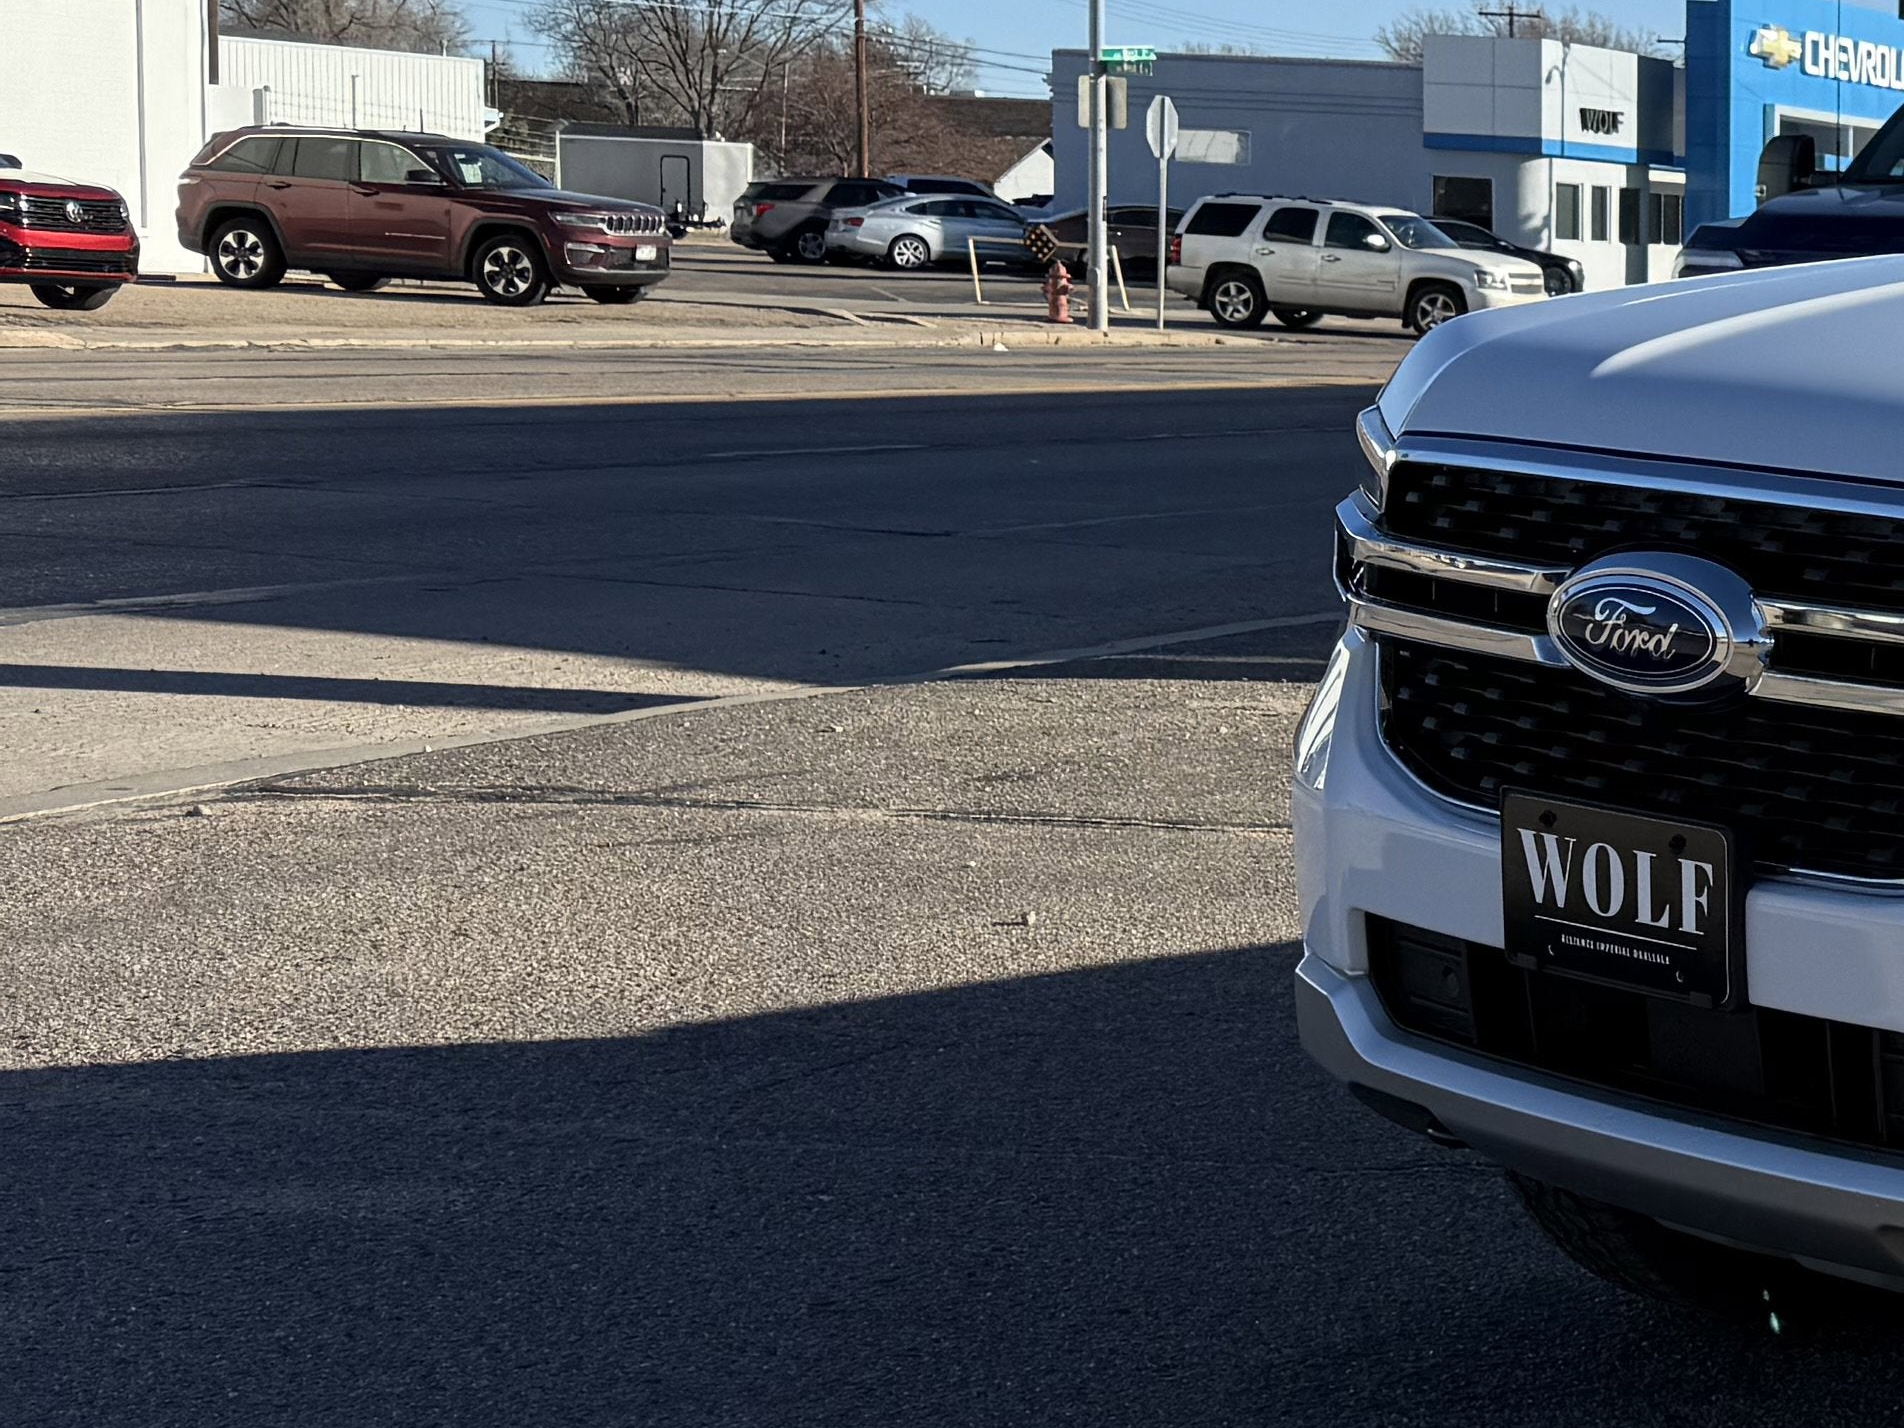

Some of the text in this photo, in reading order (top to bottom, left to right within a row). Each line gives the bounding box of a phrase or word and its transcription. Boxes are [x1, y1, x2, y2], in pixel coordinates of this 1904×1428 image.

[1579, 107, 1624, 135] WOLF
[1585, 597, 1679, 660] Ford
[1516, 827, 1714, 936] WOLF
